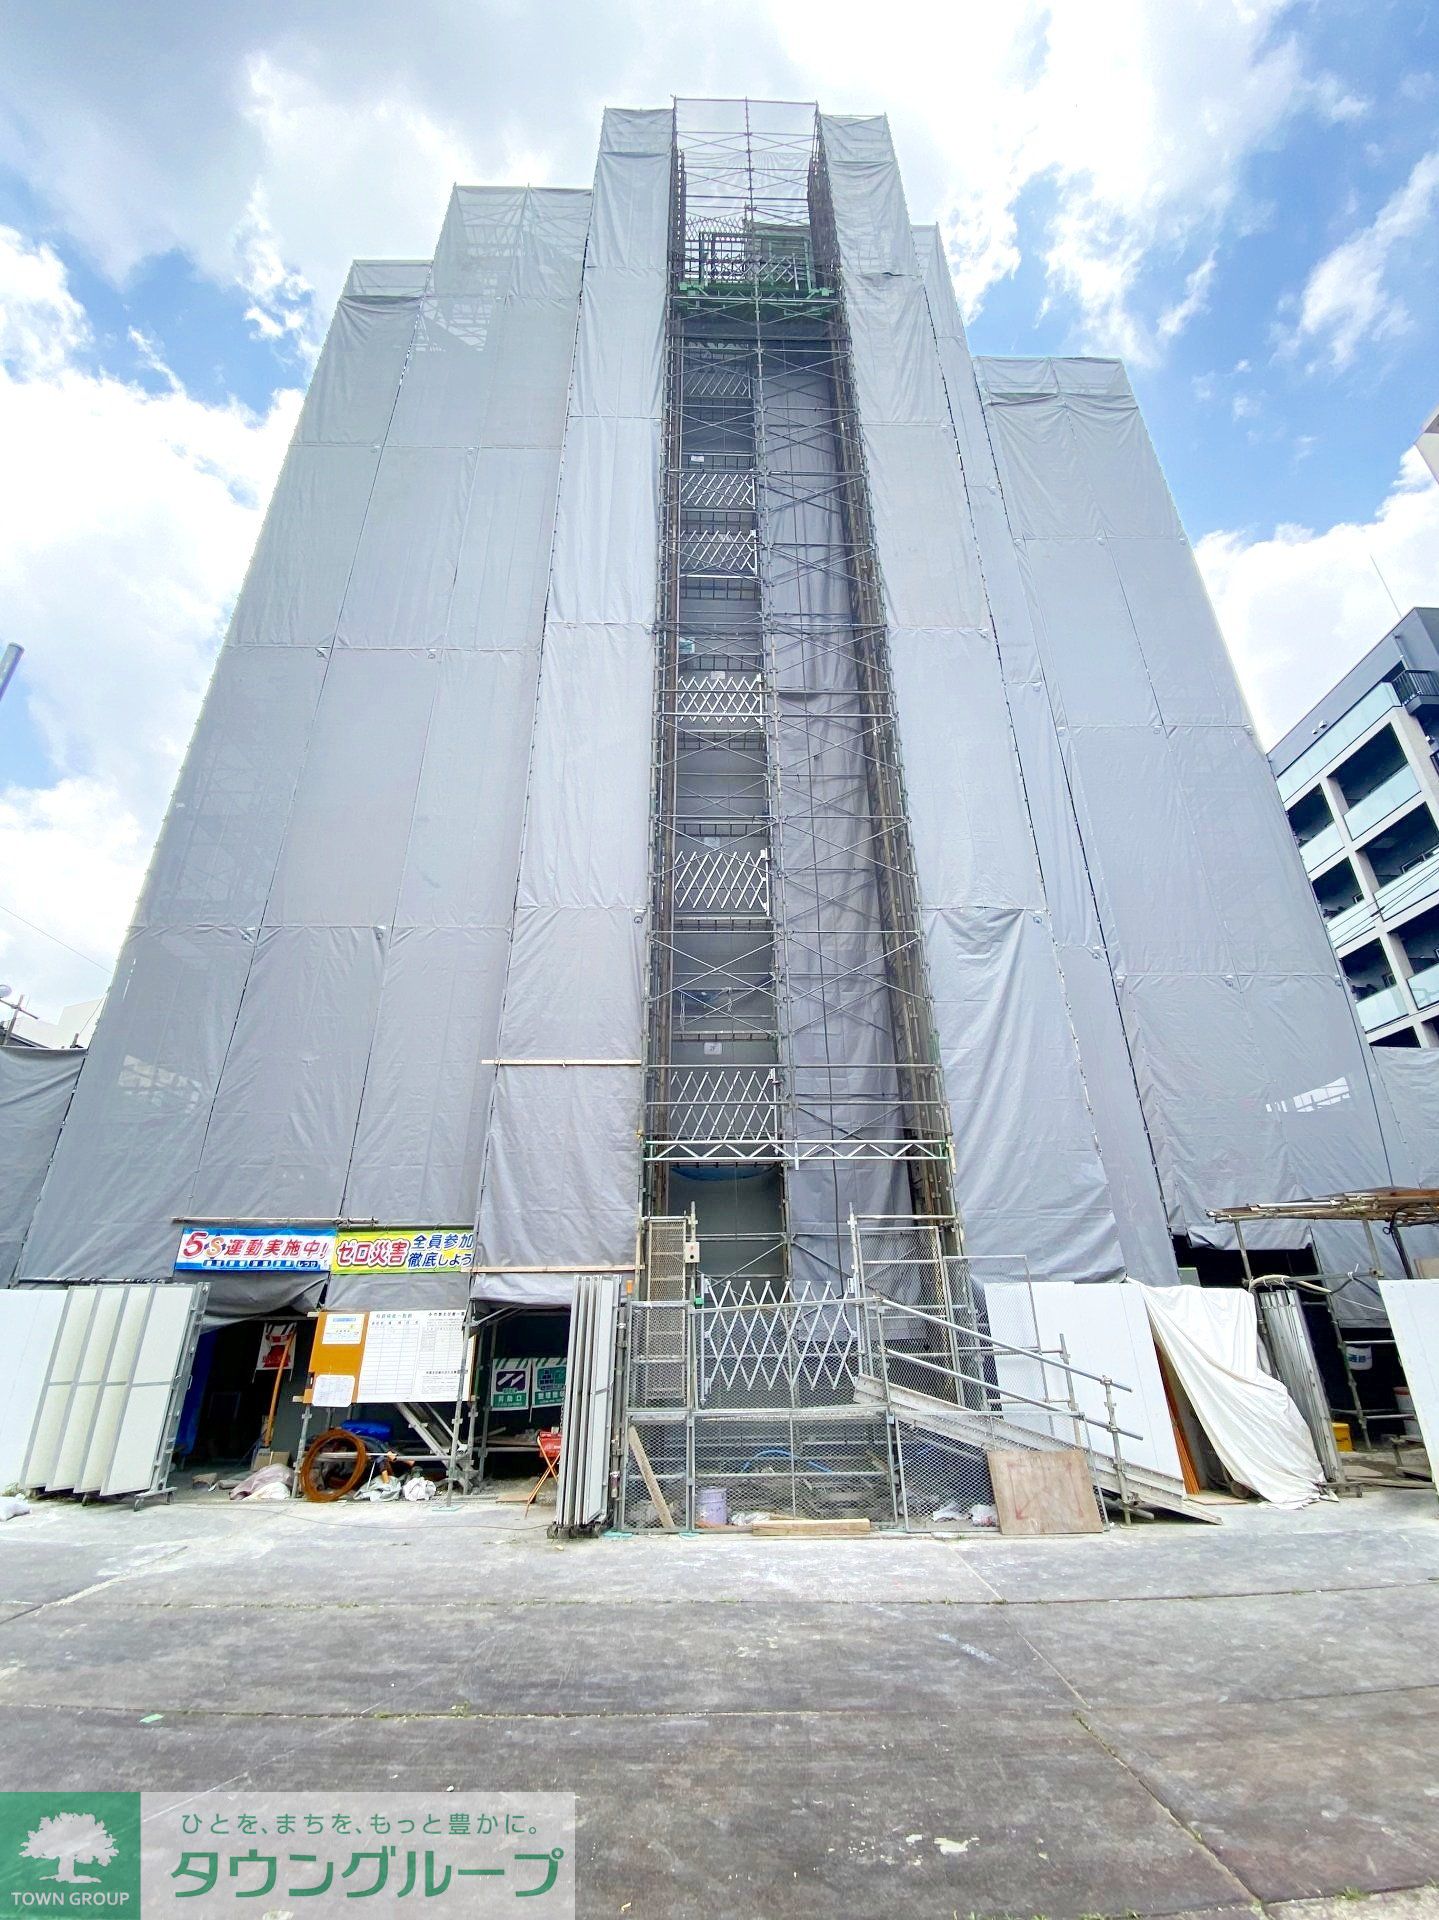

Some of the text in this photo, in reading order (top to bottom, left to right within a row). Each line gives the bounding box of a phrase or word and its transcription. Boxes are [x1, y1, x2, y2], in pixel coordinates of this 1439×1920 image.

[412, 1234, 473, 1249] 全員参加
[338, 1240, 408, 1265] ゼロ災害
[408, 1252, 472, 1267] 徹底しよう
